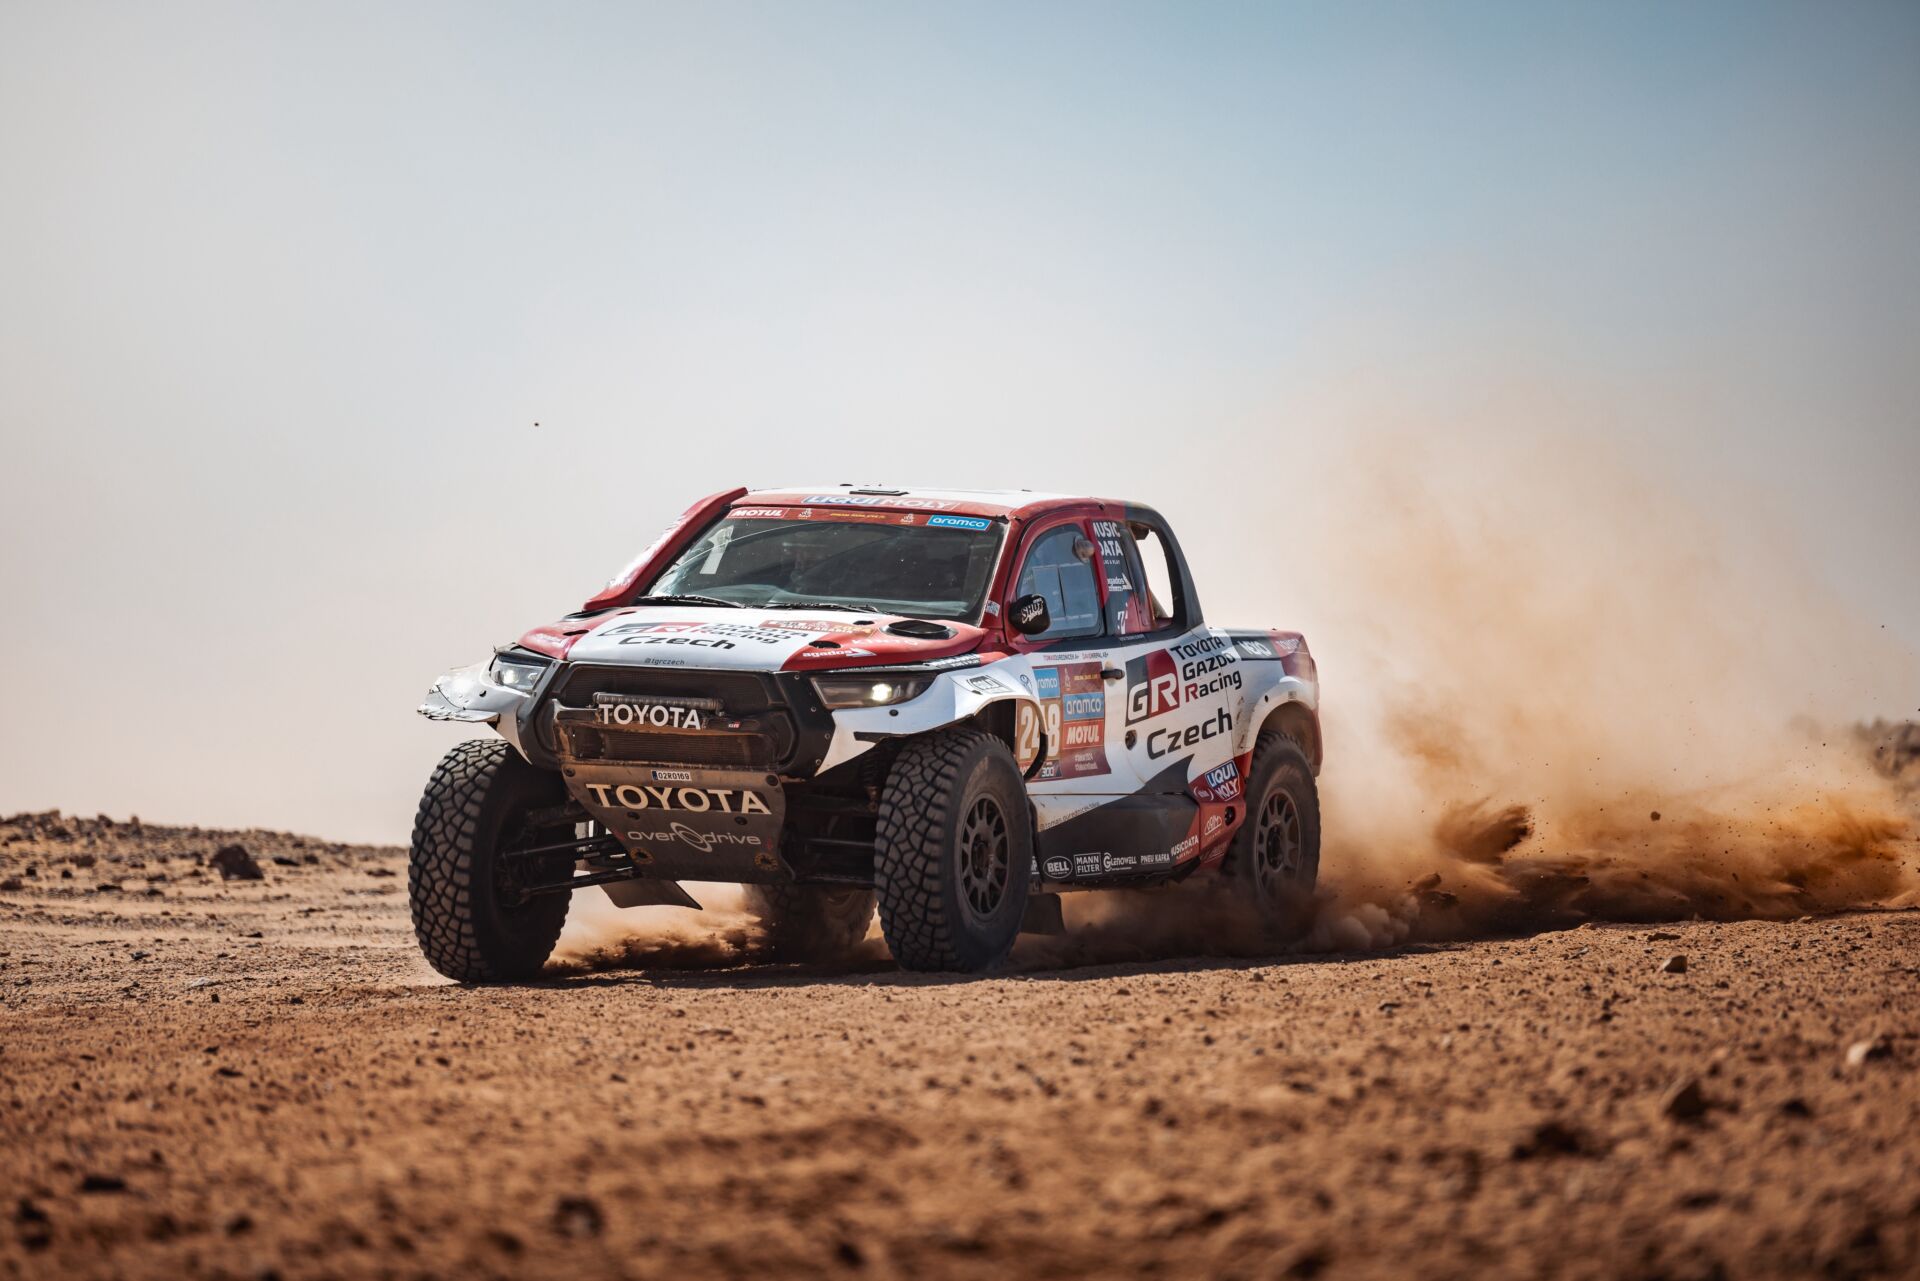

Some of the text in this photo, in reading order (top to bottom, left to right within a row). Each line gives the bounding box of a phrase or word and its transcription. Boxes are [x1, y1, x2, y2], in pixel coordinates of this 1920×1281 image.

[880, 498, 951, 510] MOLY
[734, 509, 783, 517] MOTUL
[932, 517, 986, 527] aramco
[618, 635, 736, 650] Czech
[1170, 636, 1225, 660] TOYOTA
[802, 649, 853, 658] agados
[1038, 678, 1058, 689] ramco
[1128, 671, 1242, 721] GR Racing
[1066, 698, 1101, 715] aramco
[599, 704, 701, 730] TOYOTA
[1067, 724, 1100, 745] MOTUL
[1147, 707, 1233, 760] Czech
[1206, 763, 1236, 788] LIQUI
[1215, 778, 1239, 800] MOLY
[586, 783, 772, 815] TOYOTA
[1047, 861, 1070, 873] BELL
[1076, 855, 1099, 865] MANN
[1077, 864, 1100, 873] FILTER
